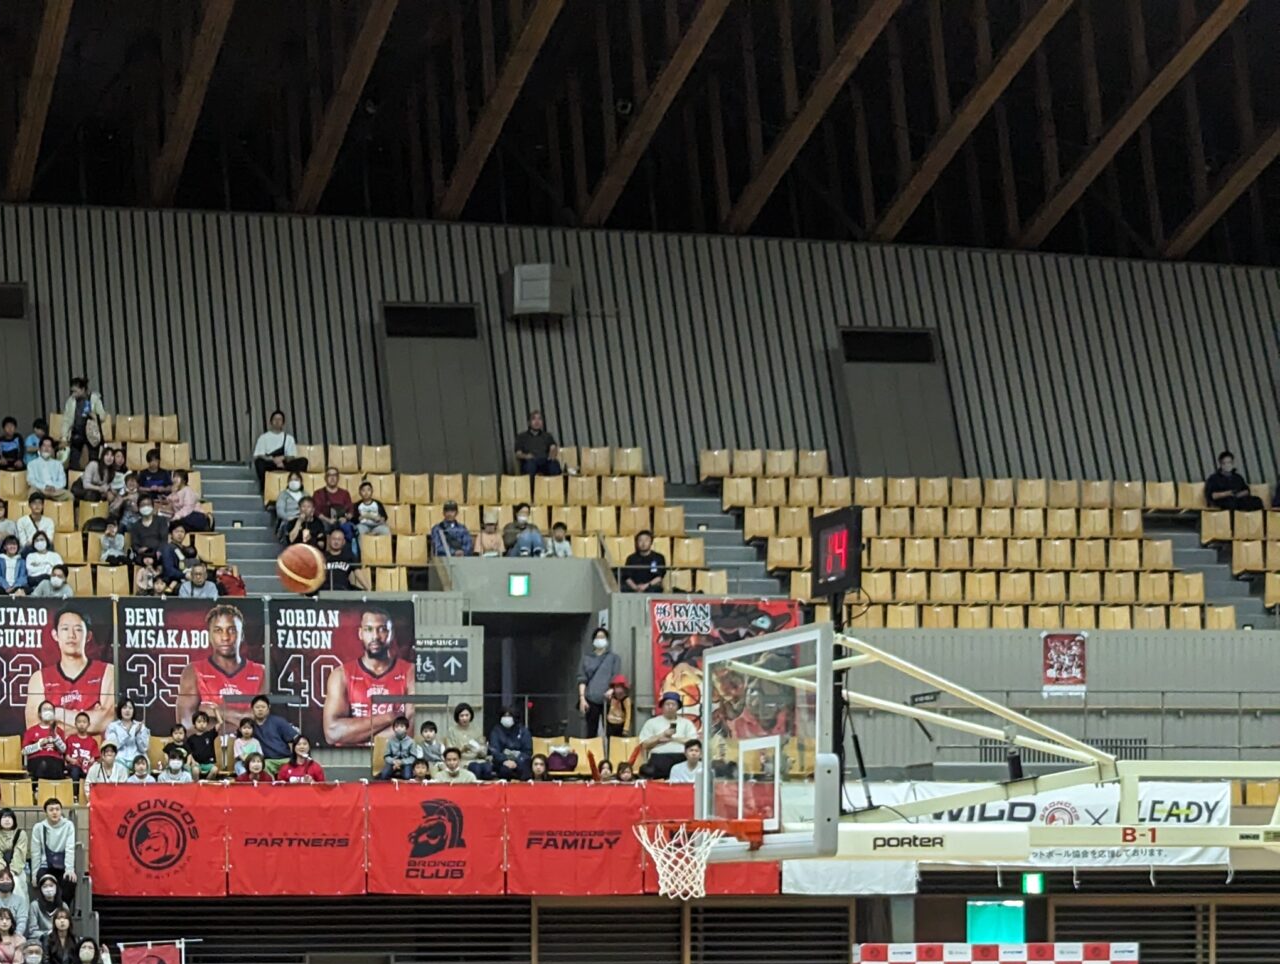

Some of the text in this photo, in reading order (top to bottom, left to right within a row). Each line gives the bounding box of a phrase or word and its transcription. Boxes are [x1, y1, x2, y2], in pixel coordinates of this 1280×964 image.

[125, 608, 164, 627] BENI
[276, 609, 339, 628] JORDAN
[655, 603, 711, 619] #6 RYAN
[657, 619, 712, 634] WATKINS
[125, 629, 209, 650] MISAKABO
[276, 630, 332, 650] FAISON
[126, 653, 190, 707] 35
[277, 654, 344, 708] 40
[116, 798, 200, 841] BRONCOS
[244, 837, 350, 848] PARTNERS
[526, 836, 622, 850] FAMILY
[1121, 827, 1157, 844] B-1
[405, 867, 465, 879] CLUB
[406, 860, 466, 868] BRONCO
